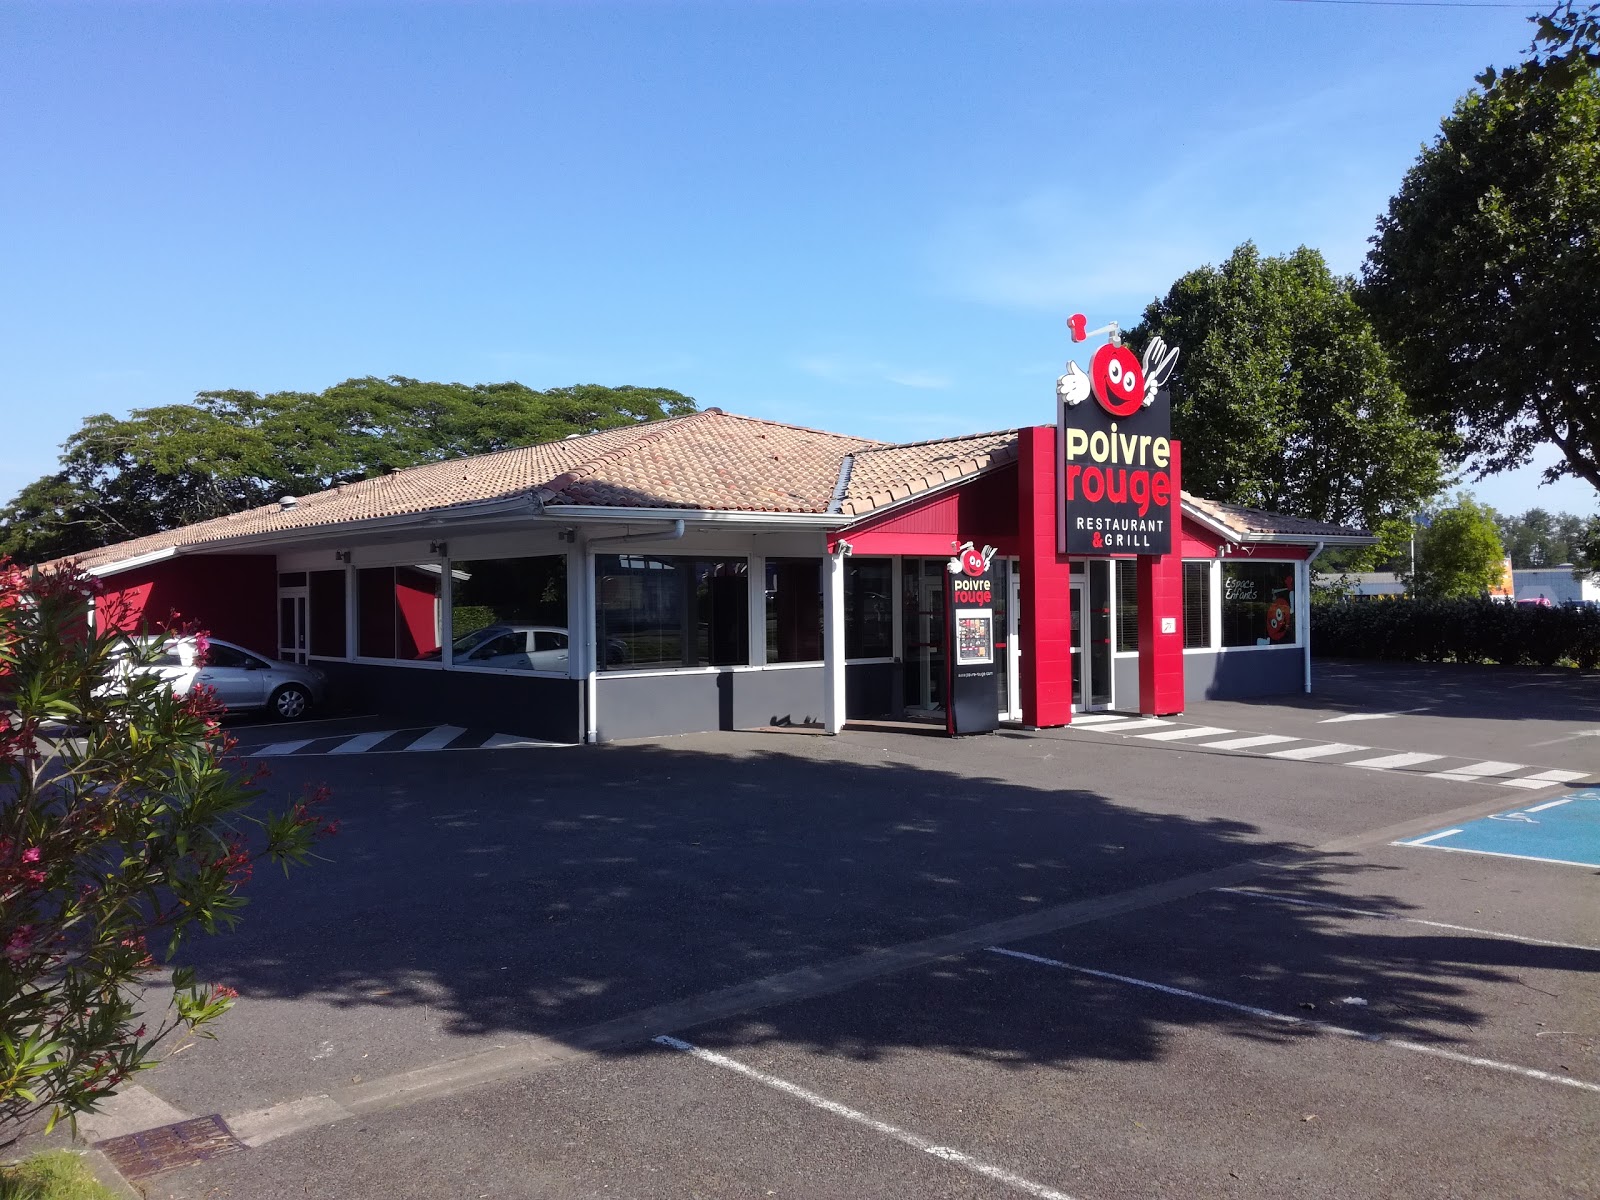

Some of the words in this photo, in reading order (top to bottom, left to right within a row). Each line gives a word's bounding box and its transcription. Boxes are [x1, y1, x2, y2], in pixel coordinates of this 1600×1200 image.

[1067, 422, 1170, 468] poivre
[1067, 465, 1170, 517] rouge
[1077, 517, 1164, 532] RESTAURANT
[954, 578, 991, 591] poivre
[1225, 577, 1255, 592] Espace
[954, 590, 992, 607] rouge
[1225, 588, 1258, 599] Enfants
